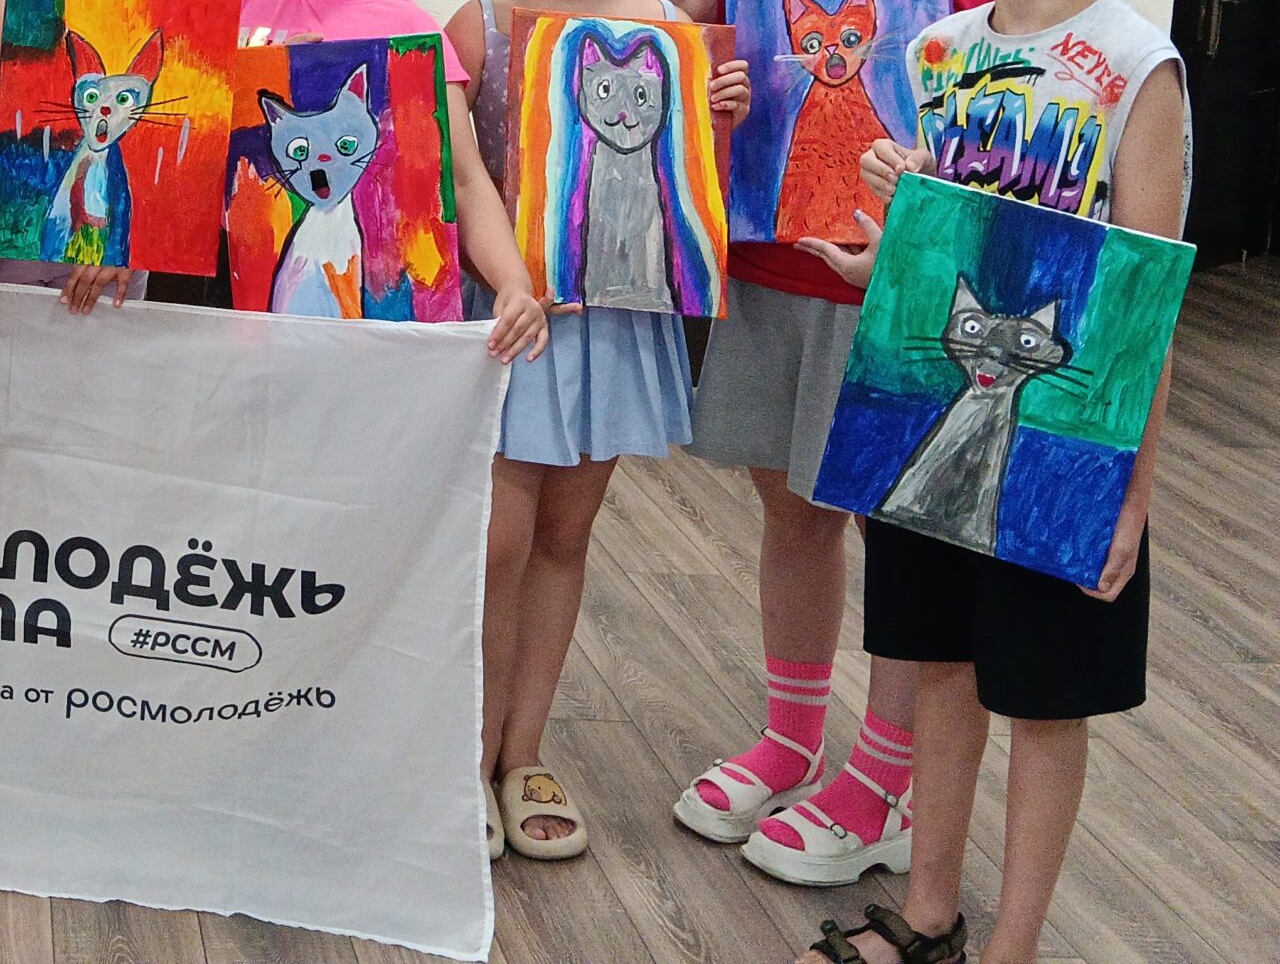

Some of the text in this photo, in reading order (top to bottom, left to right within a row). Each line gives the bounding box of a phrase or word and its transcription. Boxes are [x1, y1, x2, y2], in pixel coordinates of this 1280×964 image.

[130, 628, 237, 661] #РССМ
[24, 687, 55, 704] от
[65, 686, 336, 725] росмолодёжь
